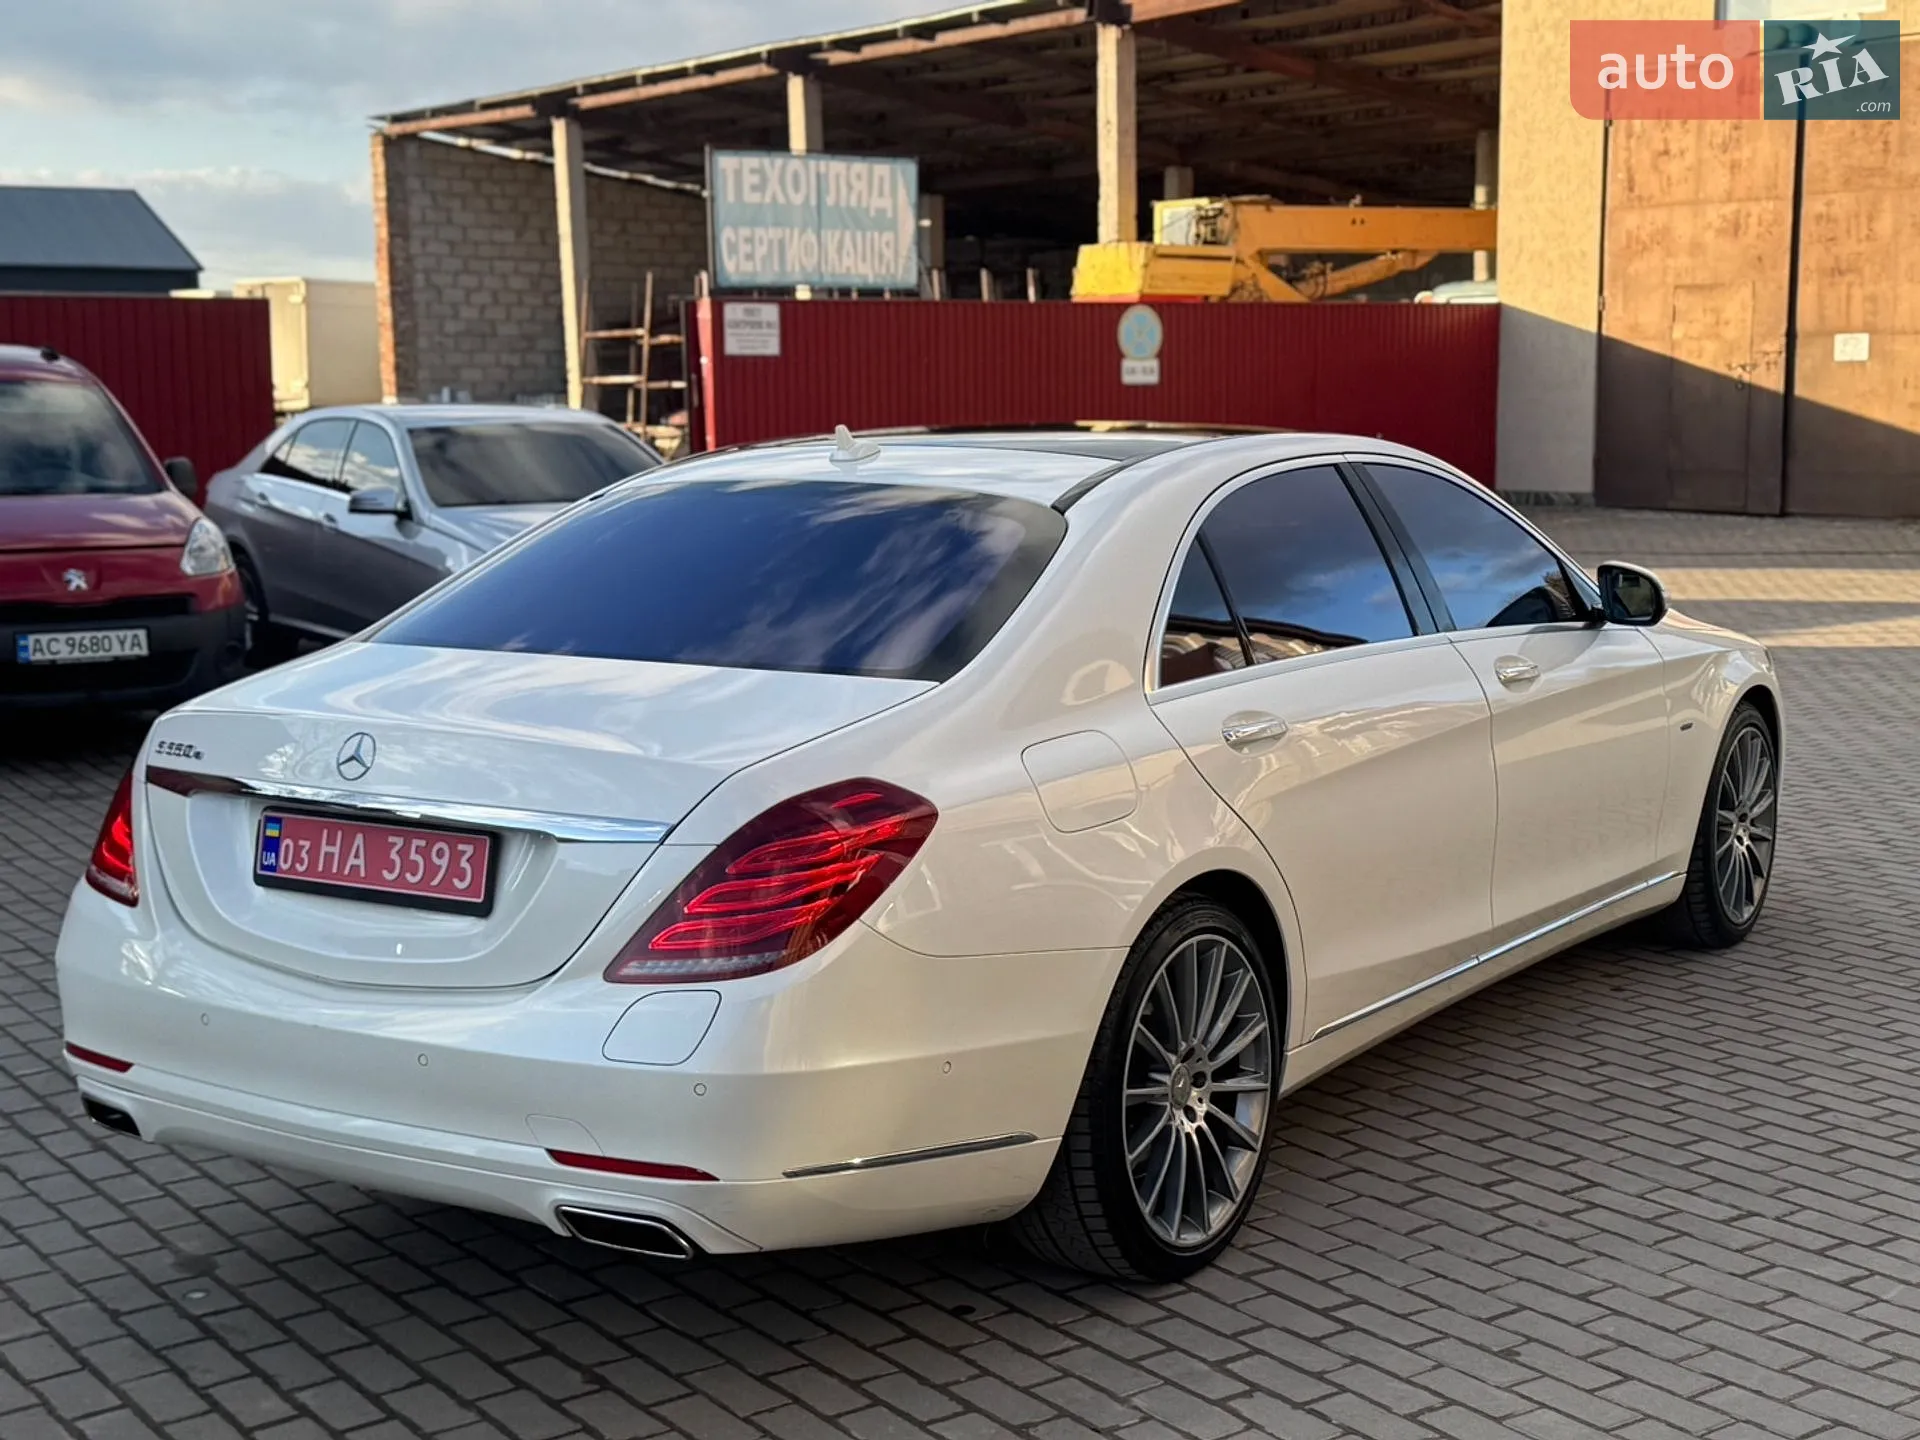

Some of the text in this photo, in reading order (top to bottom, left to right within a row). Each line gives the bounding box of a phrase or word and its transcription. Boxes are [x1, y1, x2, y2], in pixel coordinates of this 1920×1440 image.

[719, 156, 893, 218] ТЕХОГЛЯД
[32, 633, 144, 657] AC 9680 YA
[262, 851, 276, 867] UA
[280, 828, 475, 890] 03 HA 3593
